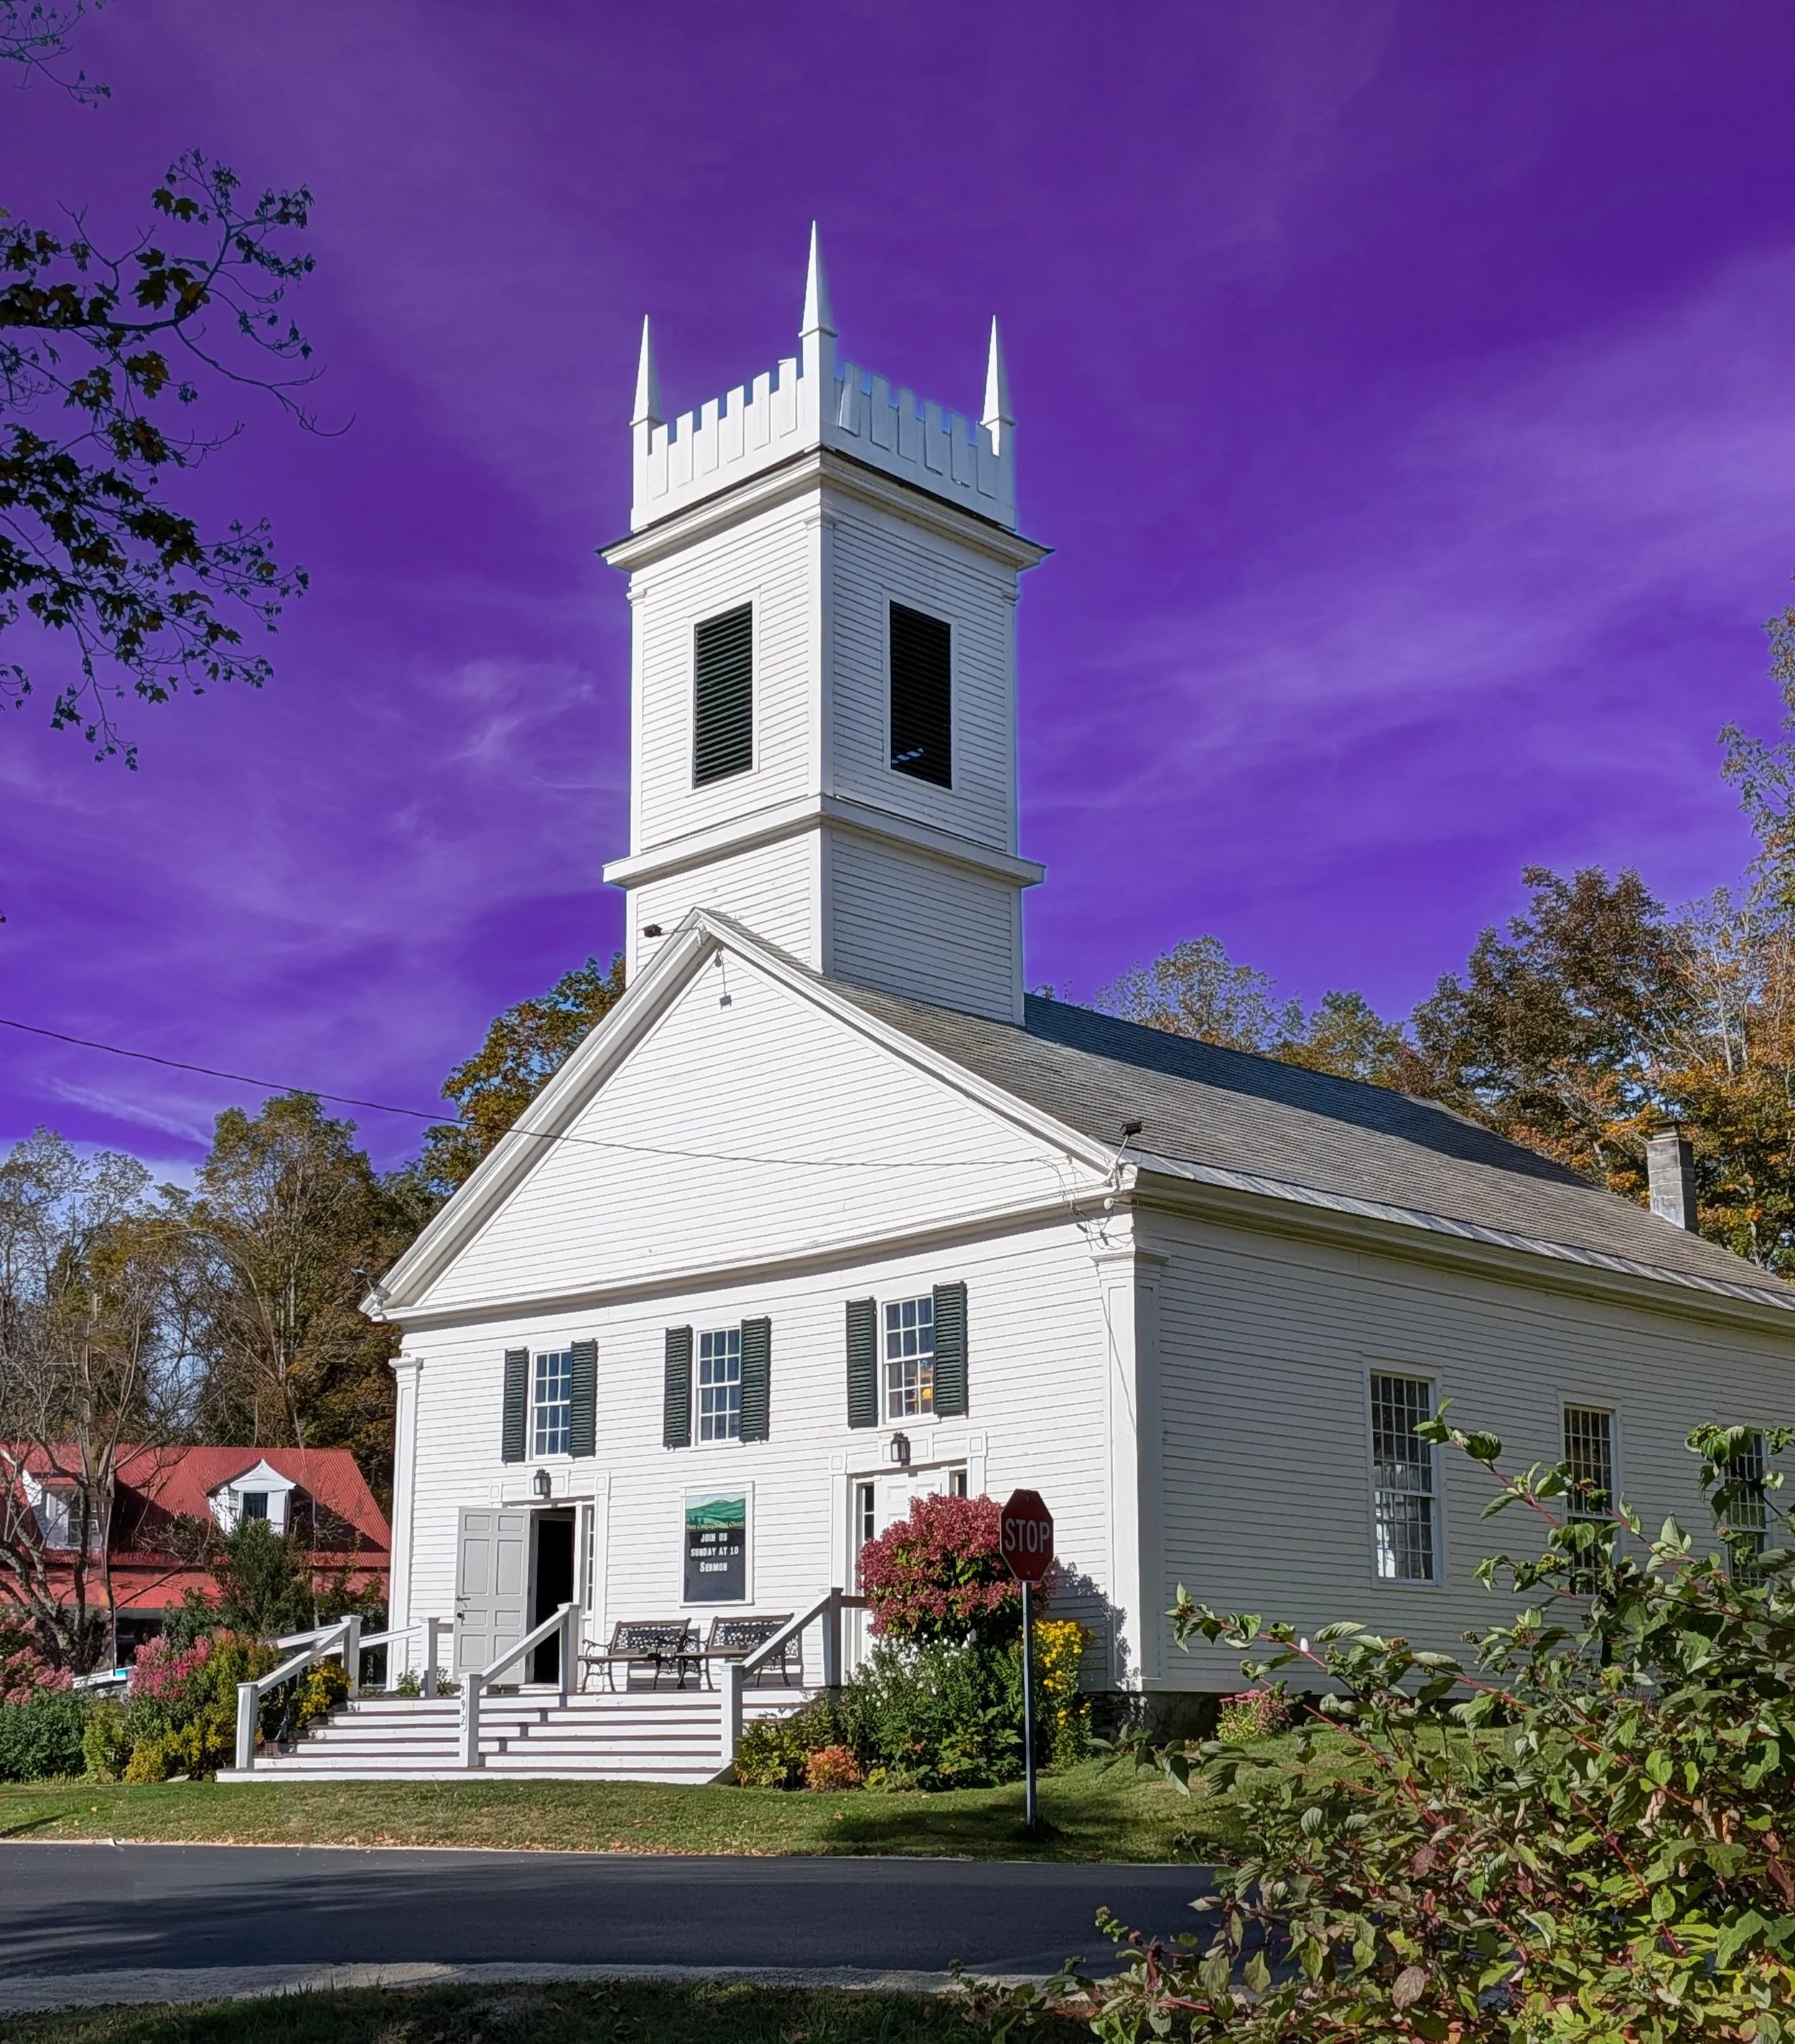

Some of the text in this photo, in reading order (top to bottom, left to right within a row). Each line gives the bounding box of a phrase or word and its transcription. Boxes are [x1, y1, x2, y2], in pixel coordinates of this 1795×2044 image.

[701, 1533, 727, 1543] JOIN US
[1005, 1518, 1050, 1553] STOP
[691, 1546, 739, 1557] SUNDAY AT 10
